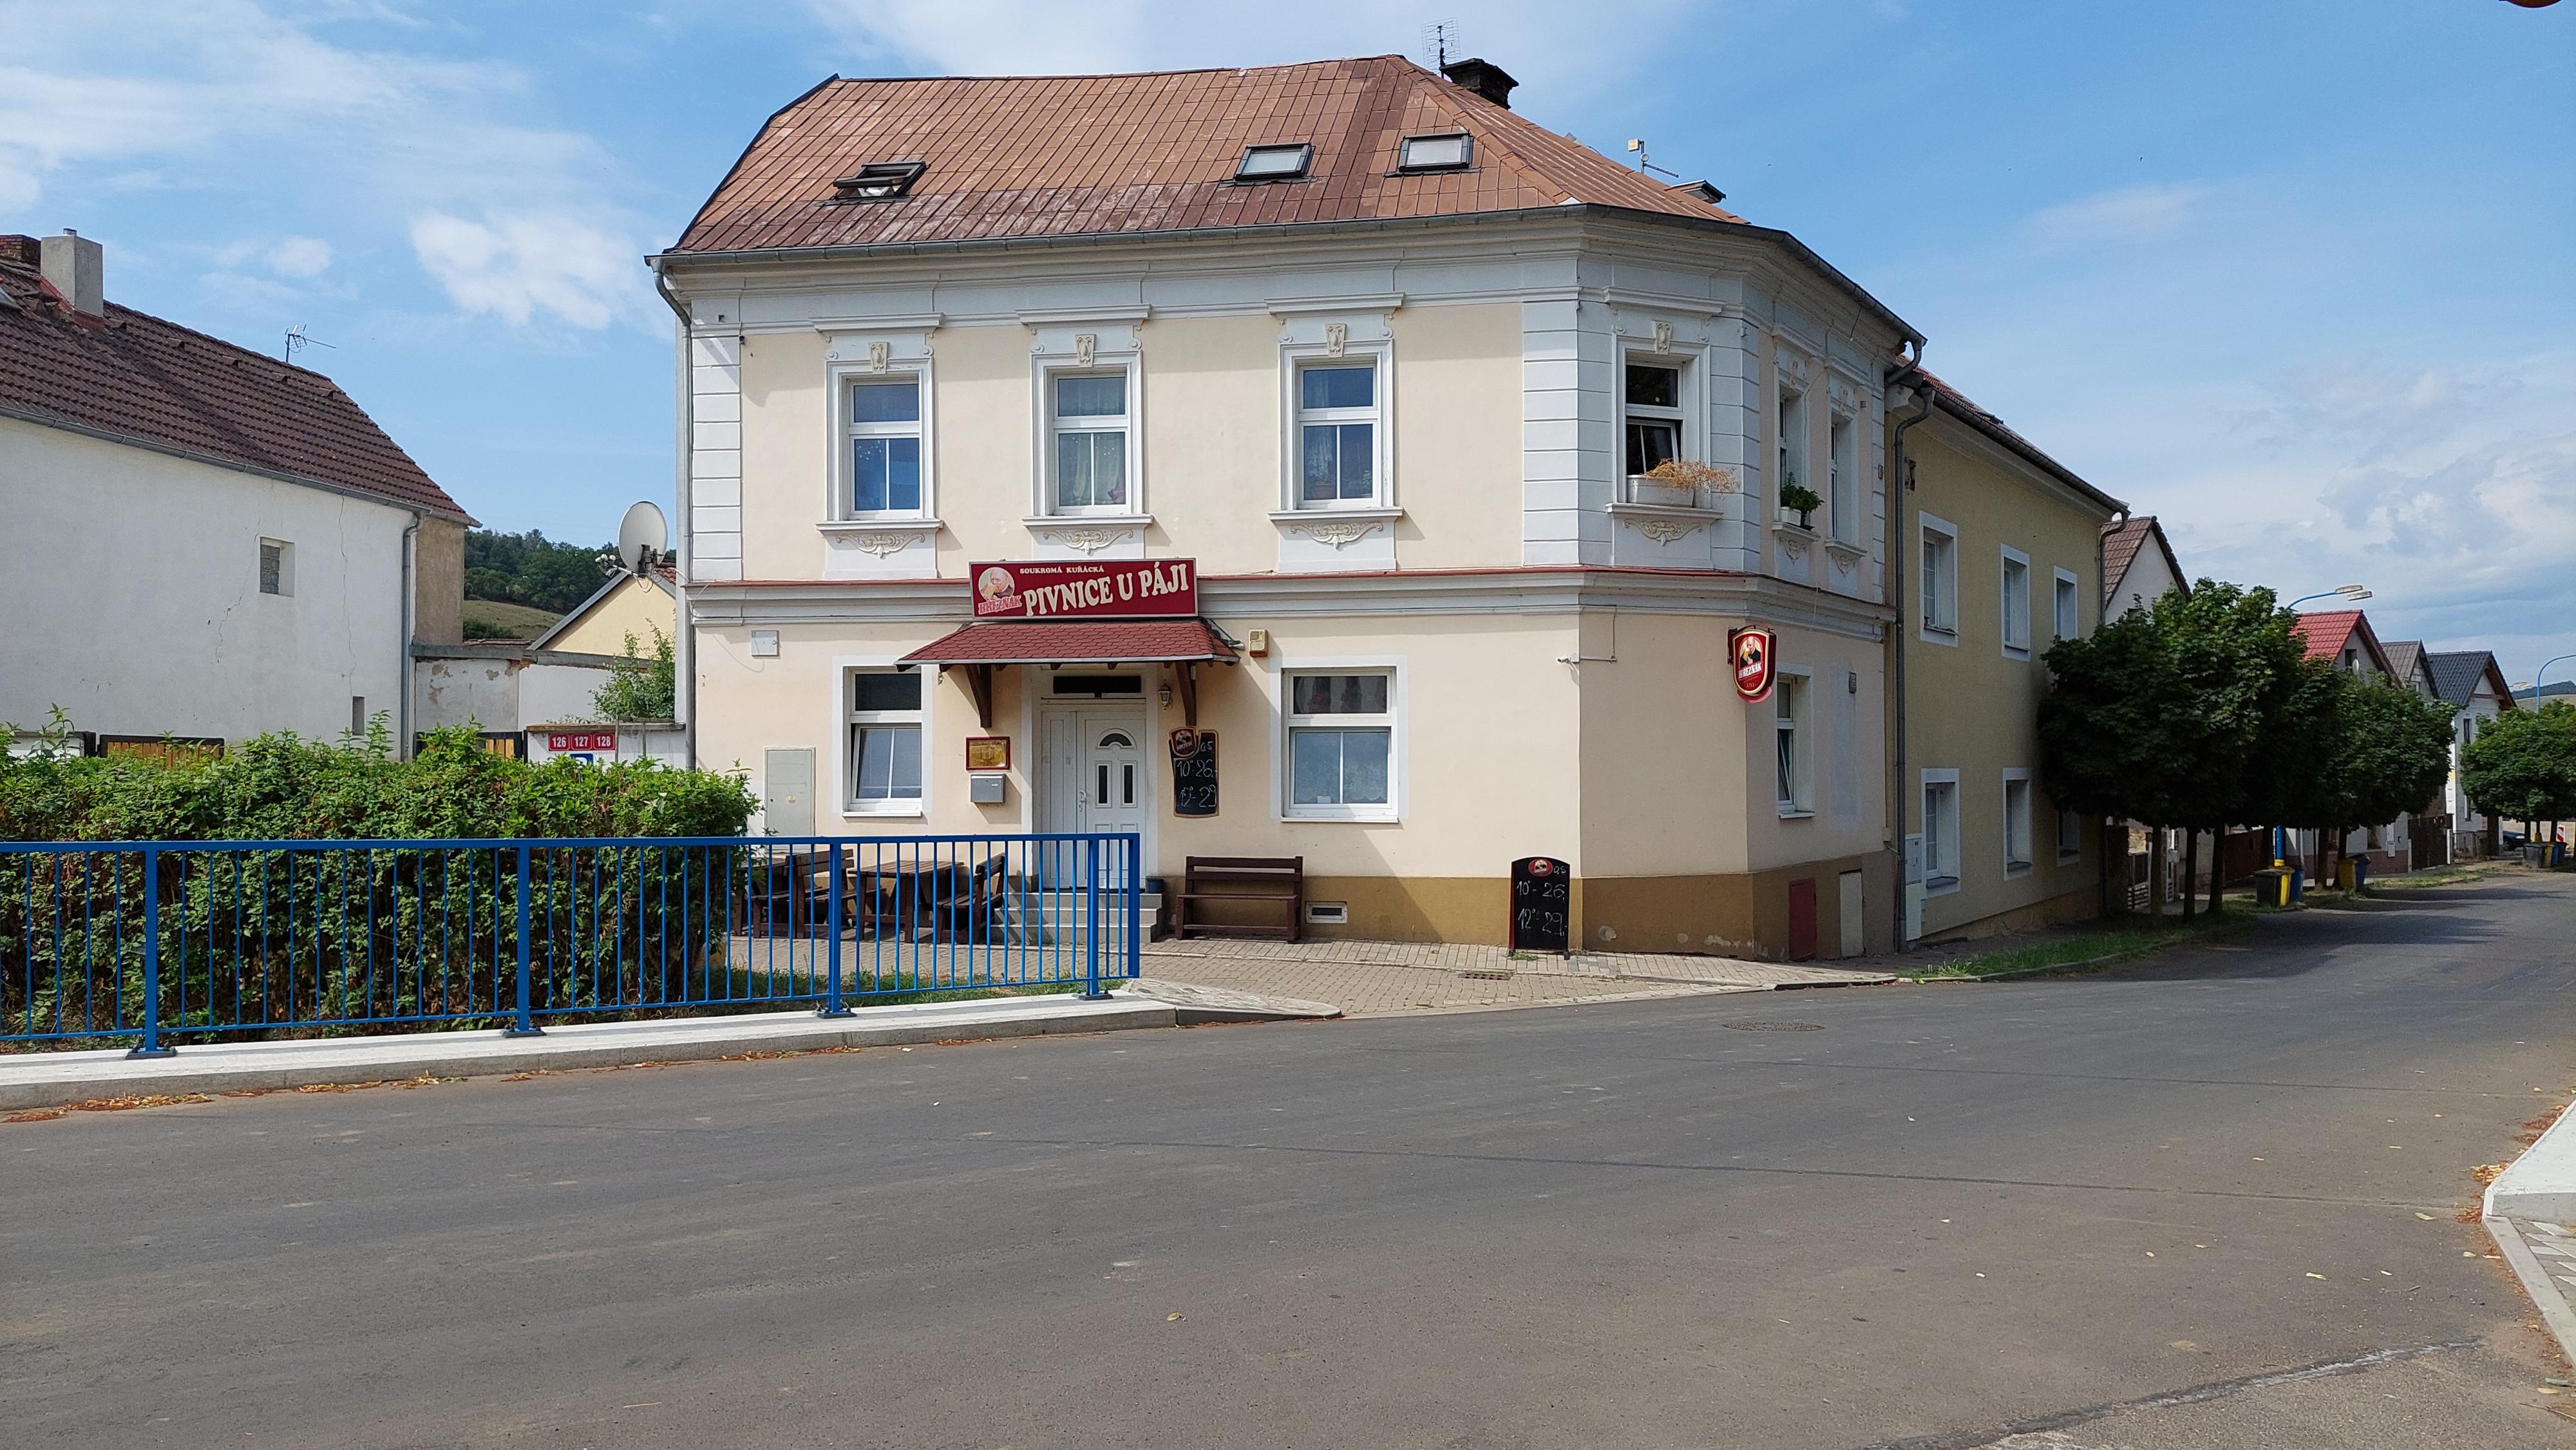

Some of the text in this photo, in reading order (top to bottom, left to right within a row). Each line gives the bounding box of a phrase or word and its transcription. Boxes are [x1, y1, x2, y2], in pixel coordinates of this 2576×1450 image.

[1023, 561, 1189, 616] PIVNICE U PÁJI
[552, 736, 611, 748] 126 127 128
